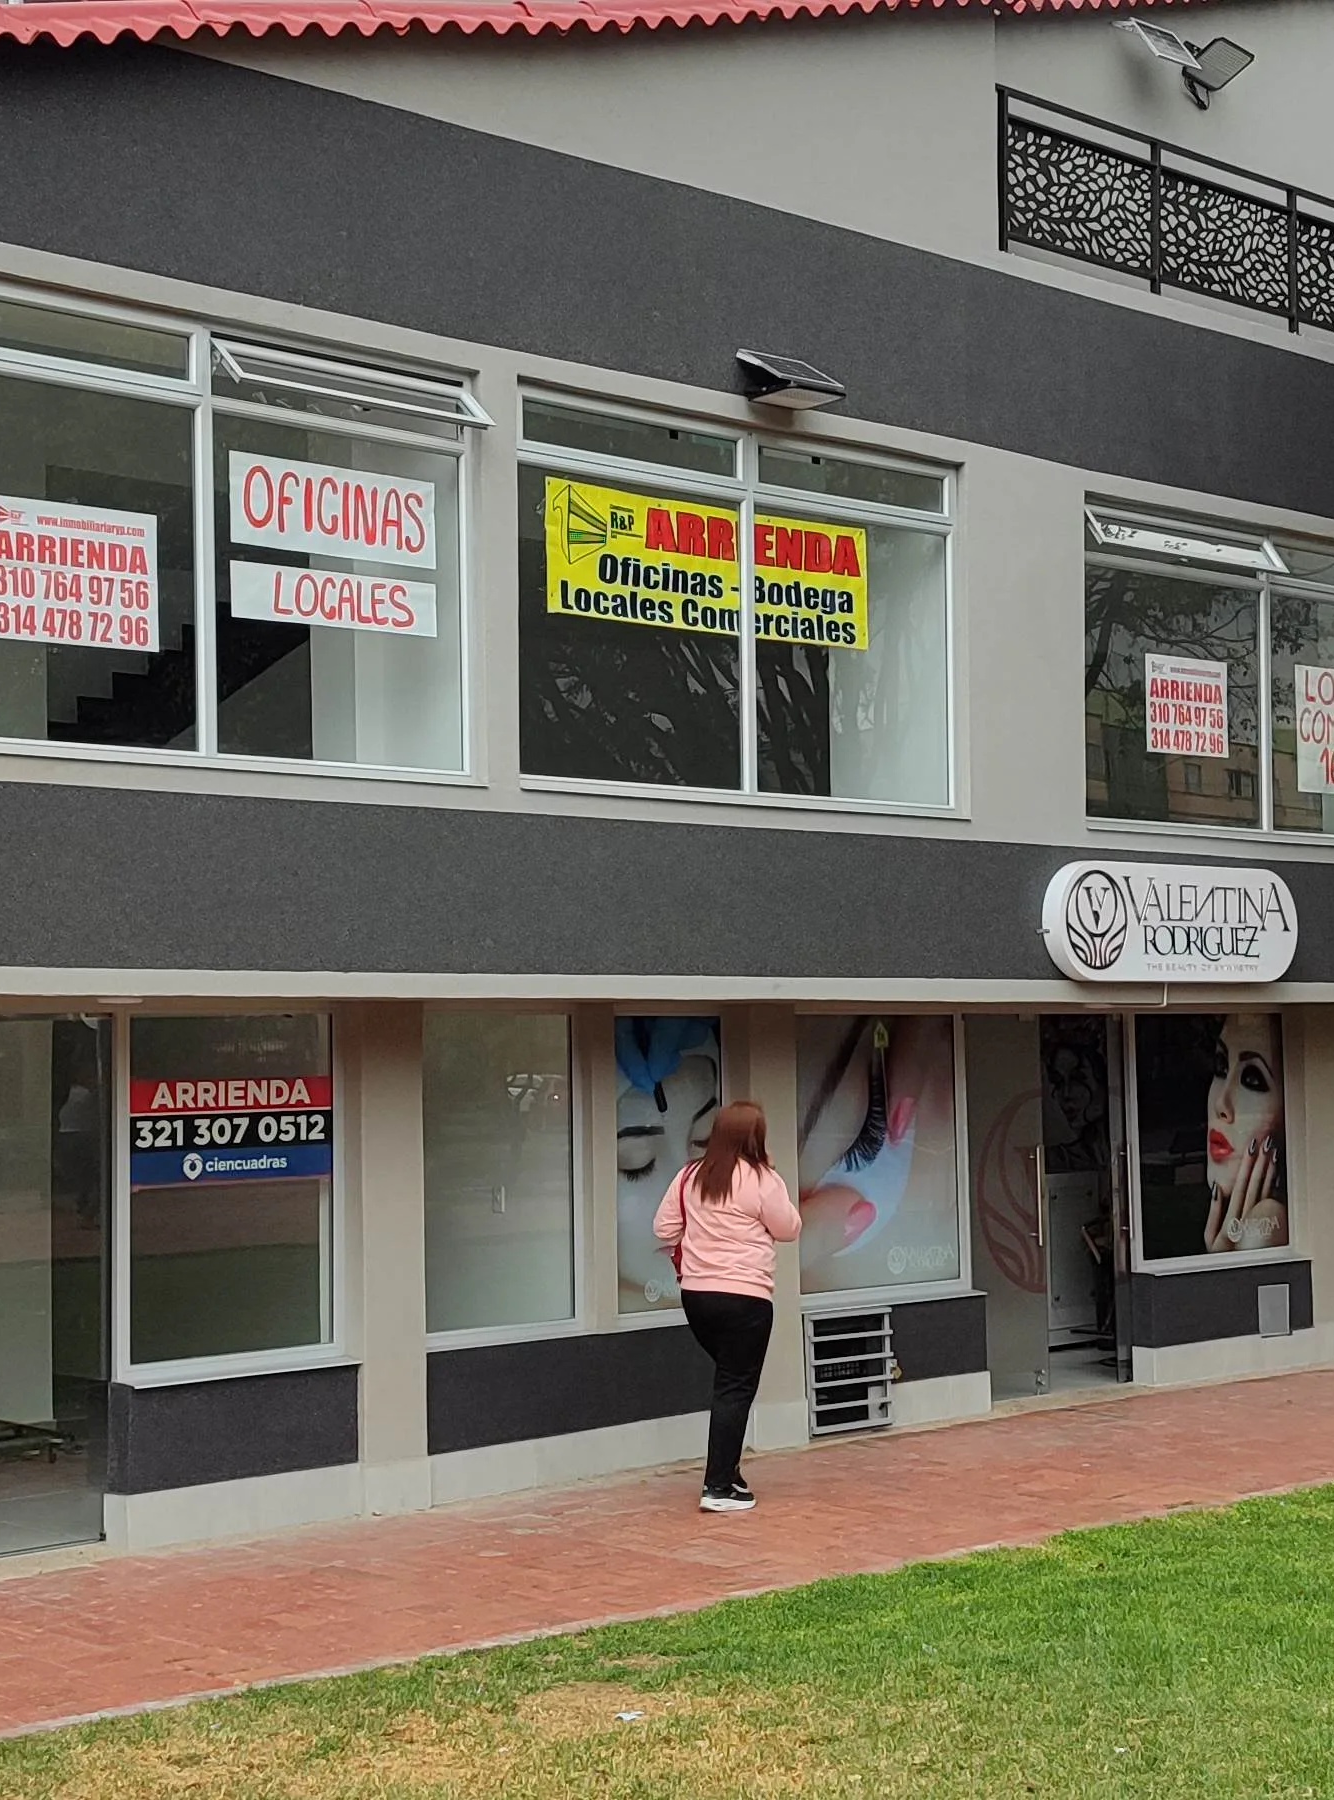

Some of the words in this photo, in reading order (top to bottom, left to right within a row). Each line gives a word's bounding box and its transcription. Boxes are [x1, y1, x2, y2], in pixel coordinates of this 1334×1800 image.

[243, 464, 427, 554] OFICINAS
[645, 506, 861, 578] ARRENDA
[40, 568, 82, 604] 764
[88, 574, 114, 607] 97
[119, 577, 149, 611] 56
[273, 570, 416, 628] LOCALES
[560, 579, 674, 625] Locales
[598, 552, 723, 599] Oficinas
[754, 574, 854, 615] Bodega
[42, 605, 82, 641] 478
[87, 611, 113, 643] 72
[118, 614, 149, 647] 96
[1149, 677, 1223, 705] ARRIENDA
[1149, 702, 1168, 724] 310
[1172, 704, 1192, 727] 764
[1194, 706, 1207, 728] 97
[1208, 708, 1224, 730] 56
[1151, 727, 1169, 750] 314
[1172, 729, 1192, 752] 478
[1195, 731, 1207, 753] 72
[1208, 733, 1224, 754] 96
[1144, 924, 1260, 961] RODRIGUEZ
[150, 1078, 311, 1110] ARRIENDA
[135, 1119, 184, 1148] 321
[193, 1117, 249, 1146] 307
[257, 1114, 325, 1143] 0512
[205, 1155, 287, 1173] ciencuadras
